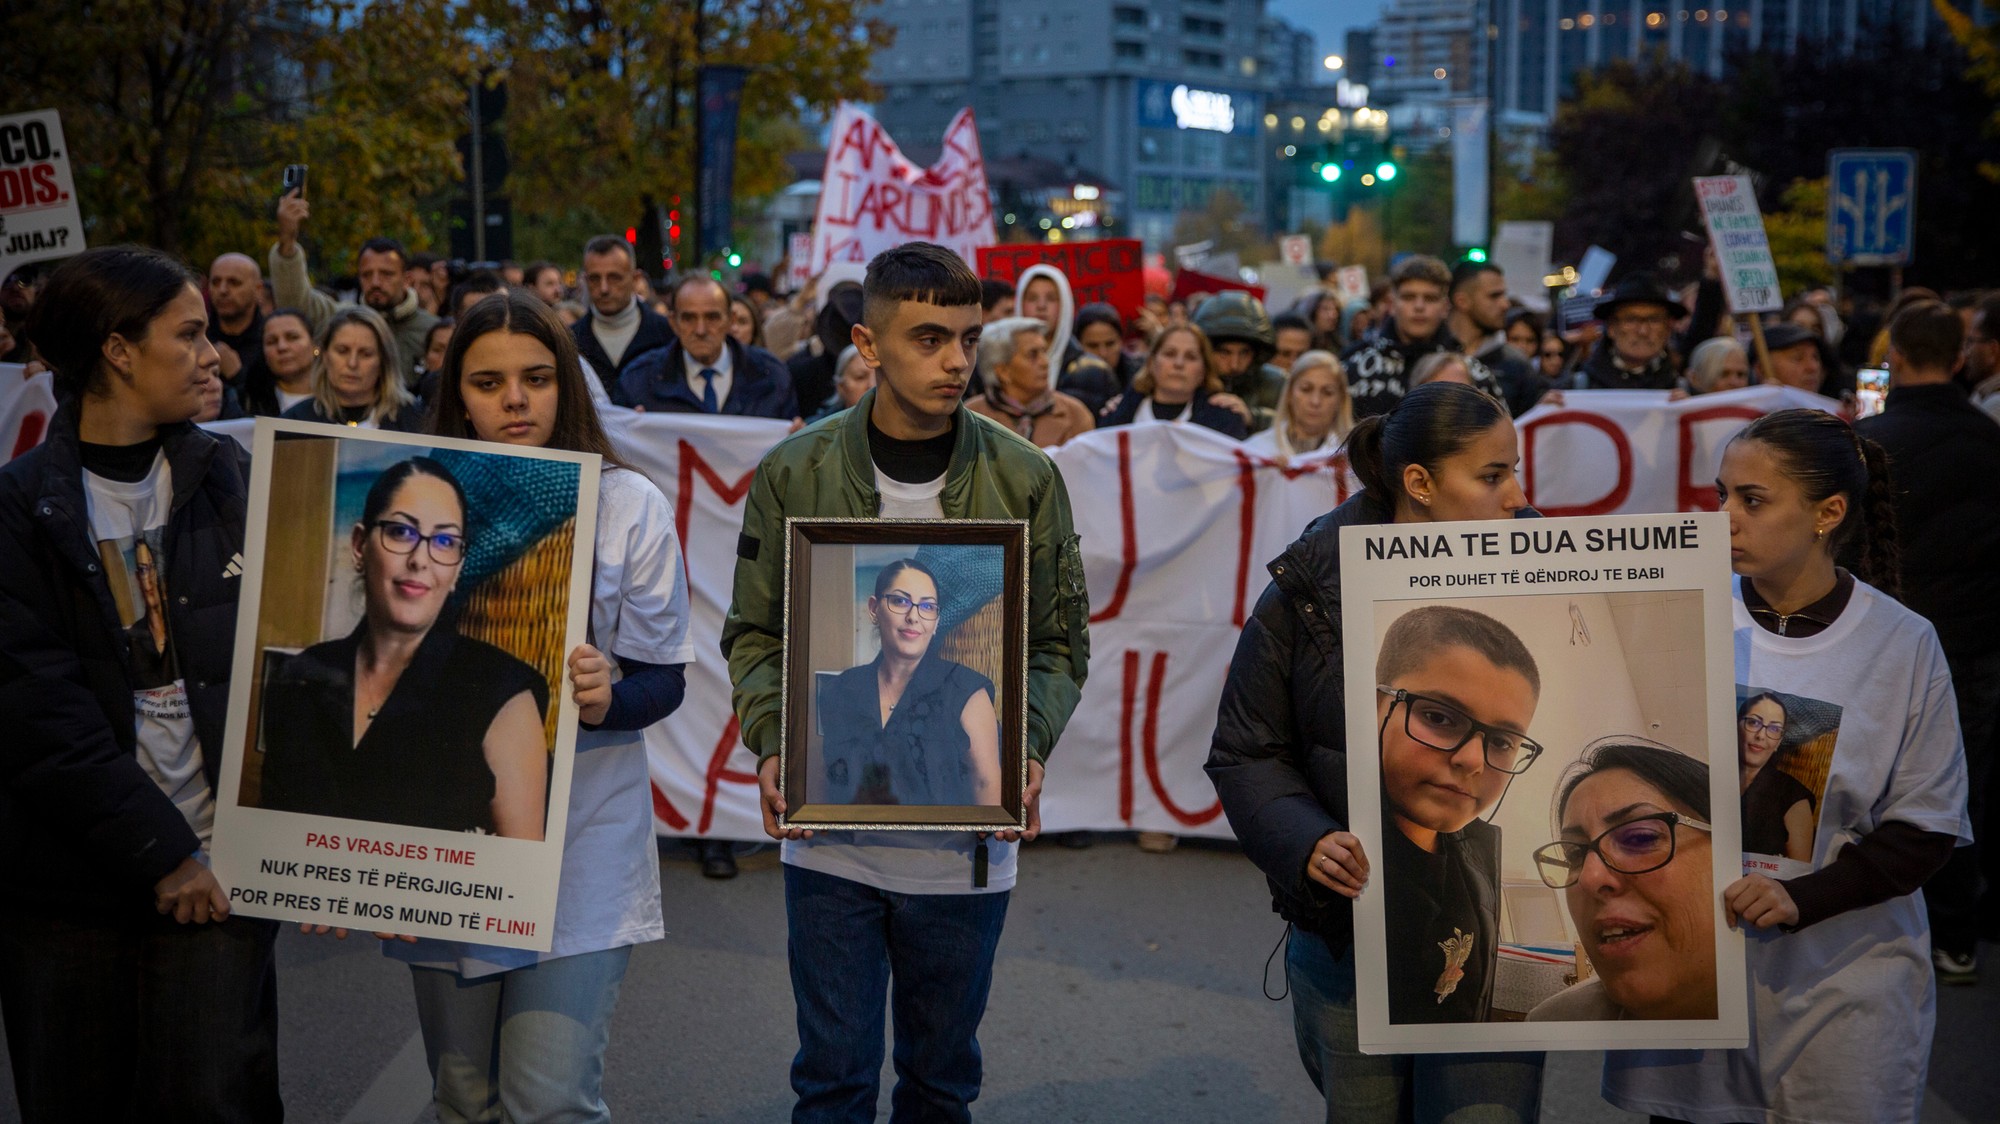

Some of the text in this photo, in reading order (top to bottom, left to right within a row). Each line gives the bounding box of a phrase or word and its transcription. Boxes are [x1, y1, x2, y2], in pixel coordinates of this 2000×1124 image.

[7, 226, 68, 253] JUAJ?
[1738, 288, 1770, 306] STOP
[1365, 519, 1699, 561] NANA TE DUA SHUMË
[1409, 566, 1665, 588] POR DUHET TË QËNDROJ TE BABI
[306, 833, 476, 866] PAS VRASJES TIME
[260, 859, 299, 877] NUK
[304, 864, 351, 883] PRES
[357, 868, 379, 886] TË
[384, 870, 503, 901] PËRGJIGJENI
[1742, 860, 1779, 871] JES TIME
[230, 887, 536, 937] POR PRES TË MOS MUND TË FLINI!
